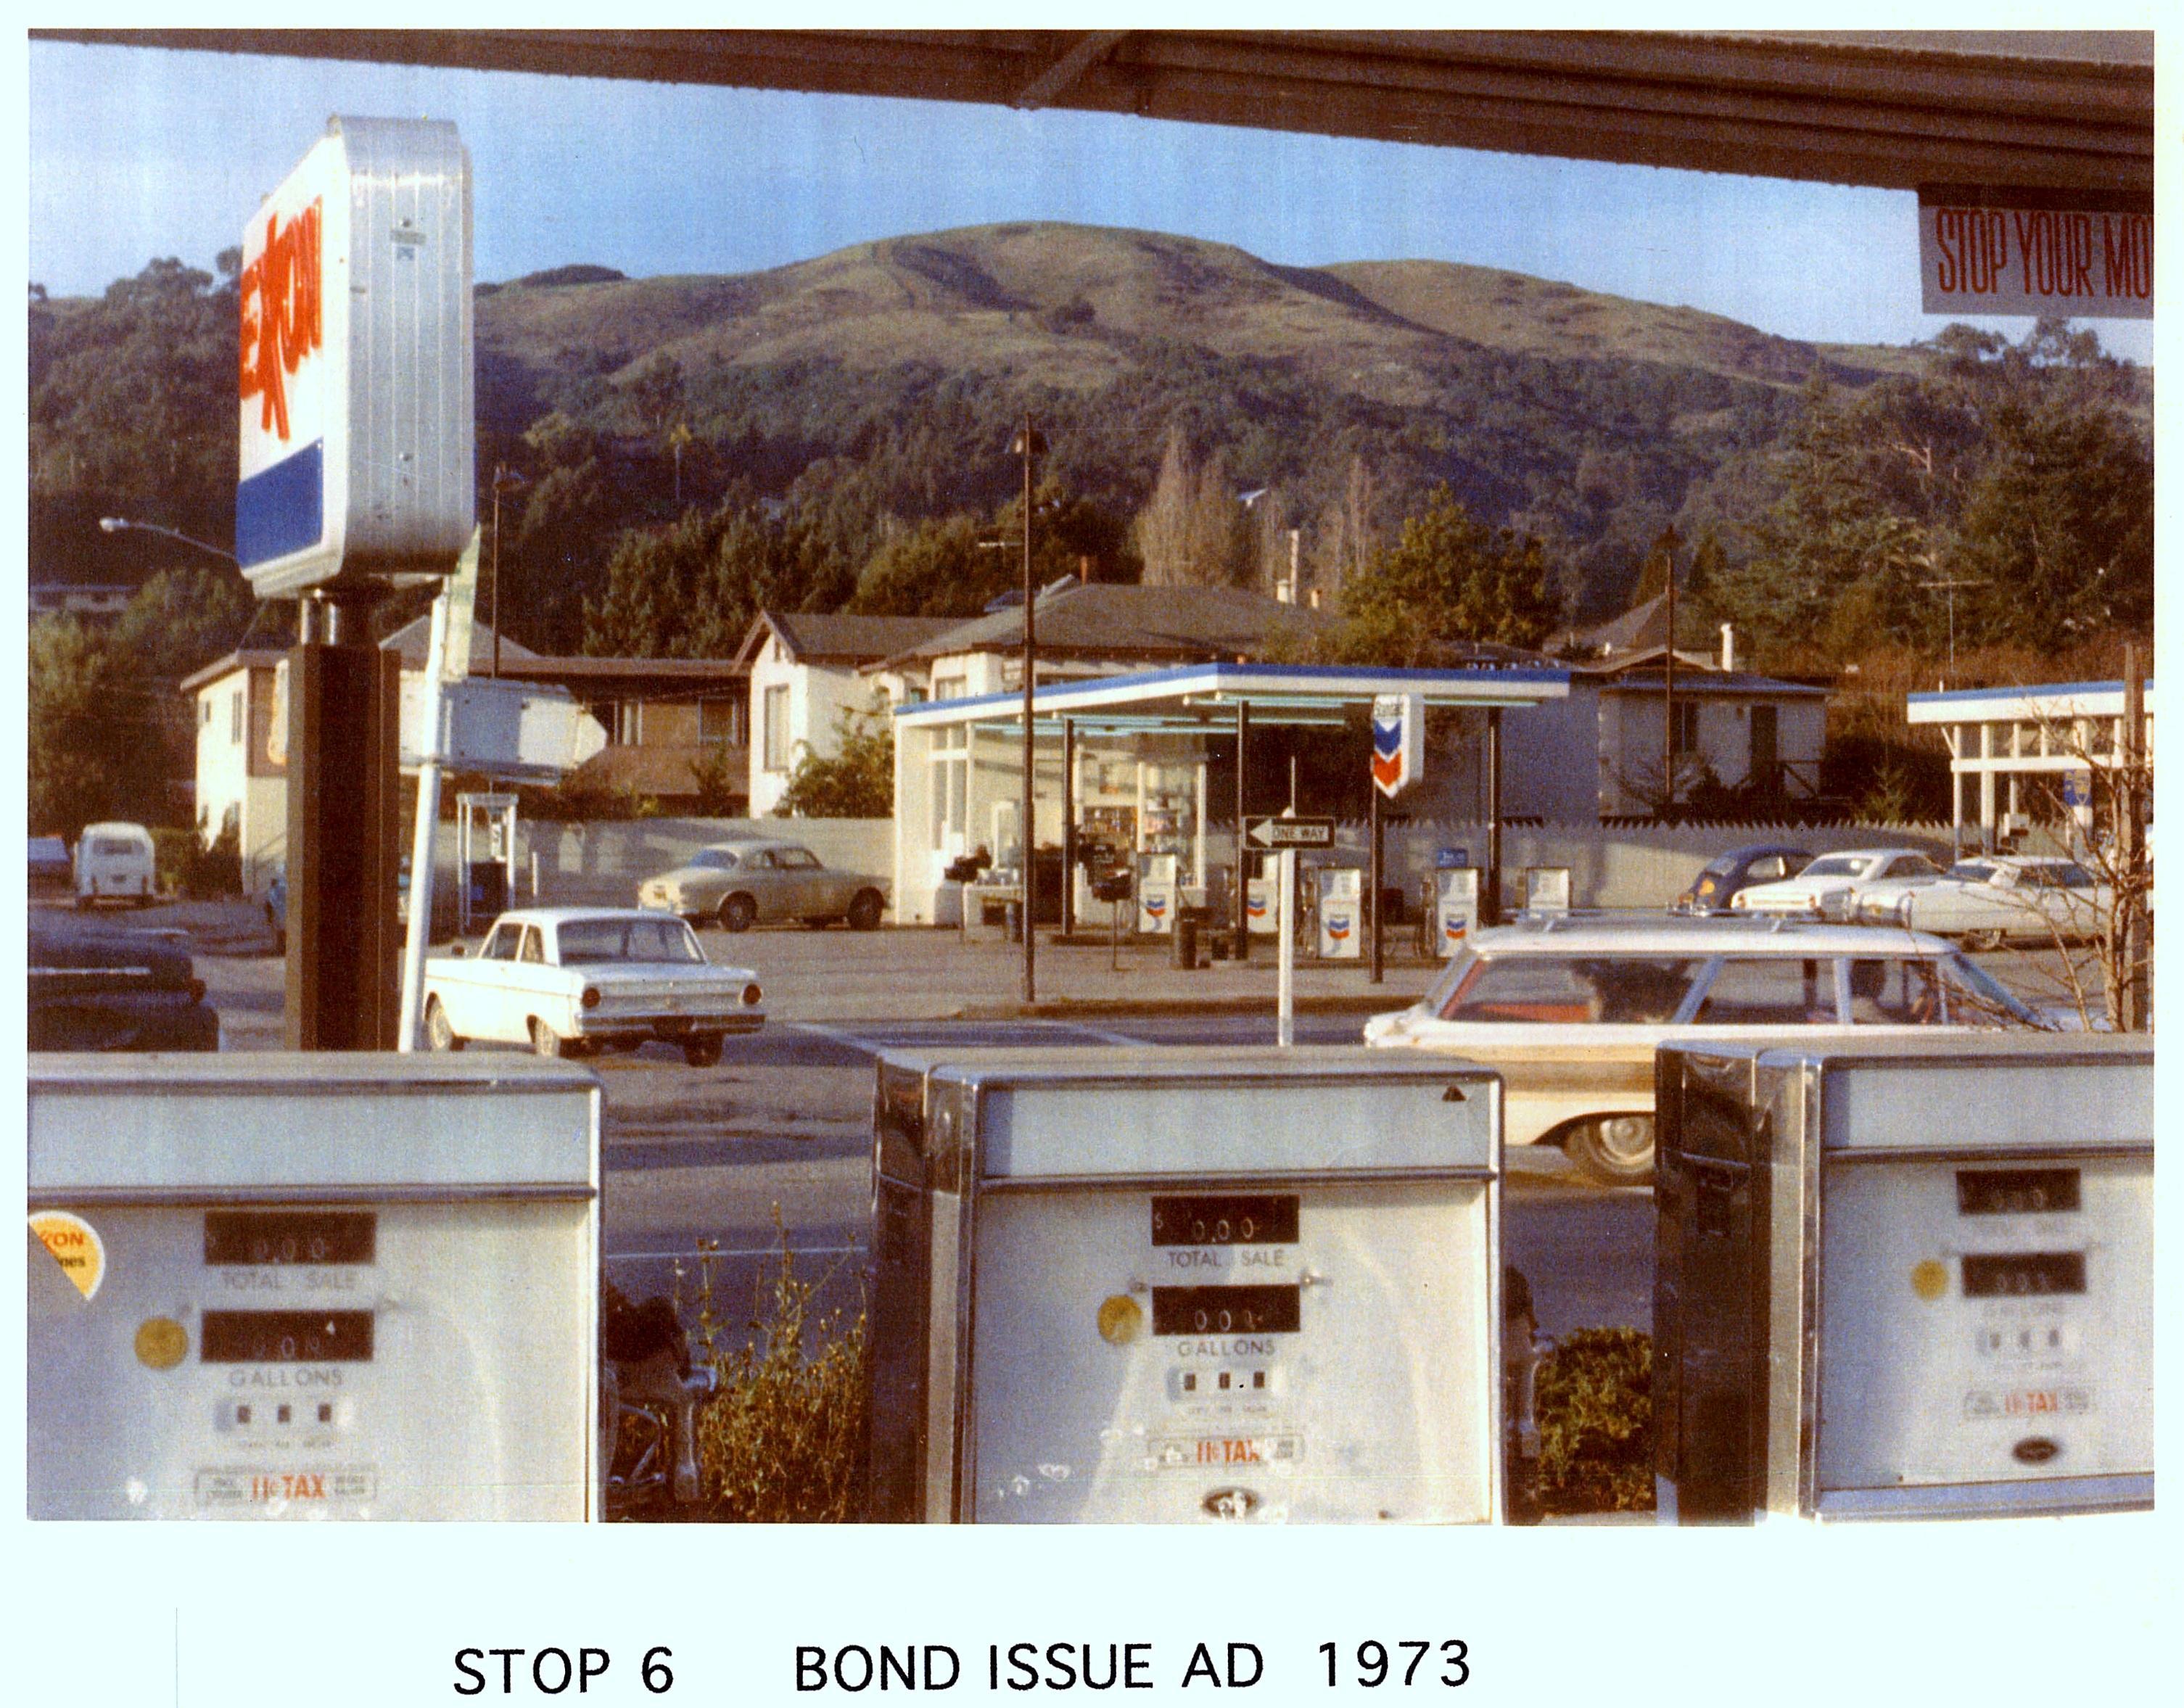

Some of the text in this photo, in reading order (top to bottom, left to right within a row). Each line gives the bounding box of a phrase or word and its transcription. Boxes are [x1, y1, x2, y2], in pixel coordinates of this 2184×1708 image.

[1936, 208, 2006, 294] STOP
[2014, 210, 2094, 297] YOUR
[1272, 827, 1325, 840] ONE WAY
[1169, 1248, 1285, 1268] TOTAL SALE
[221, 1268, 357, 1290] TOTAL SALE
[1178, 1337, 1275, 1357] GALLONS
[228, 1368, 344, 1387] GALLONS
[1223, 1437, 1261, 1463] TAX
[281, 1472, 326, 1500] TAX
